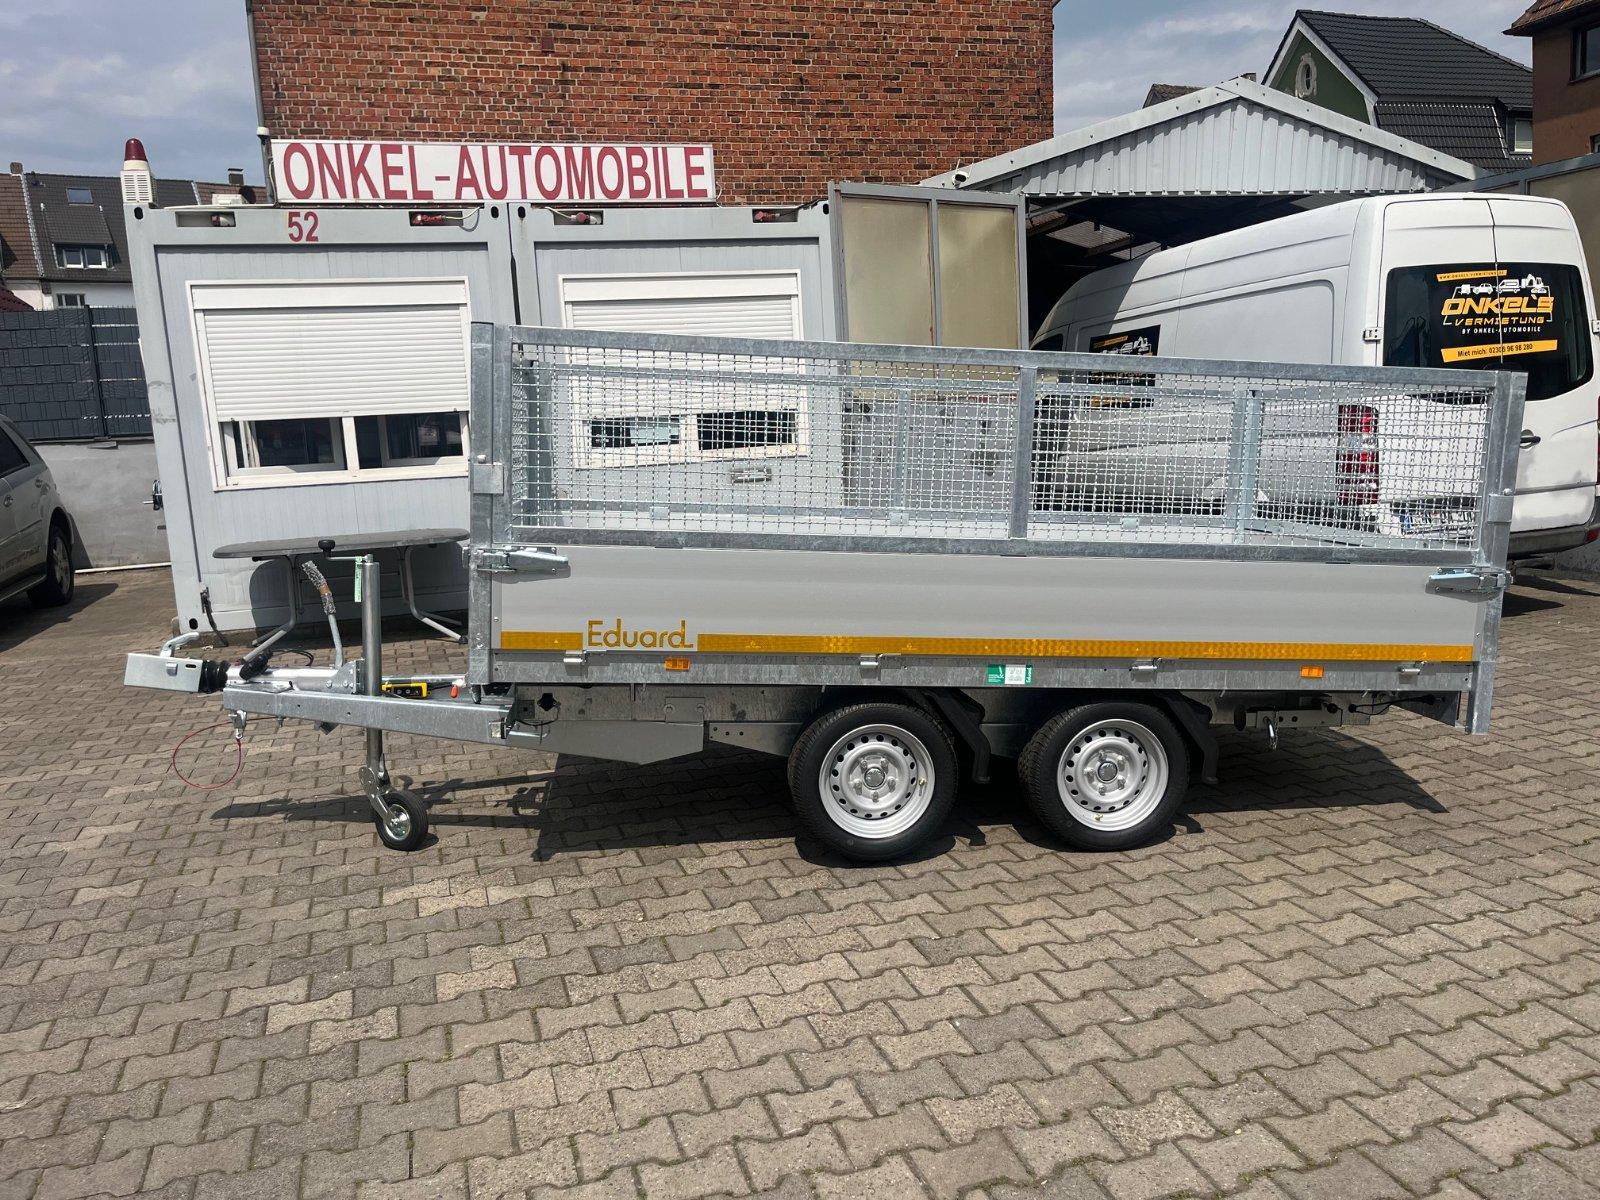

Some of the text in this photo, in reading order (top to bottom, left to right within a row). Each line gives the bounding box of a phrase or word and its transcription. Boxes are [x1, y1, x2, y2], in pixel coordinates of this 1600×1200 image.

[283, 142, 709, 201] ONKEL-AUTOMOBILE
[287, 211, 319, 243] 52
[1454, 316, 1545, 327] VERMIETUNG
[587, 618, 694, 648] Eduard
